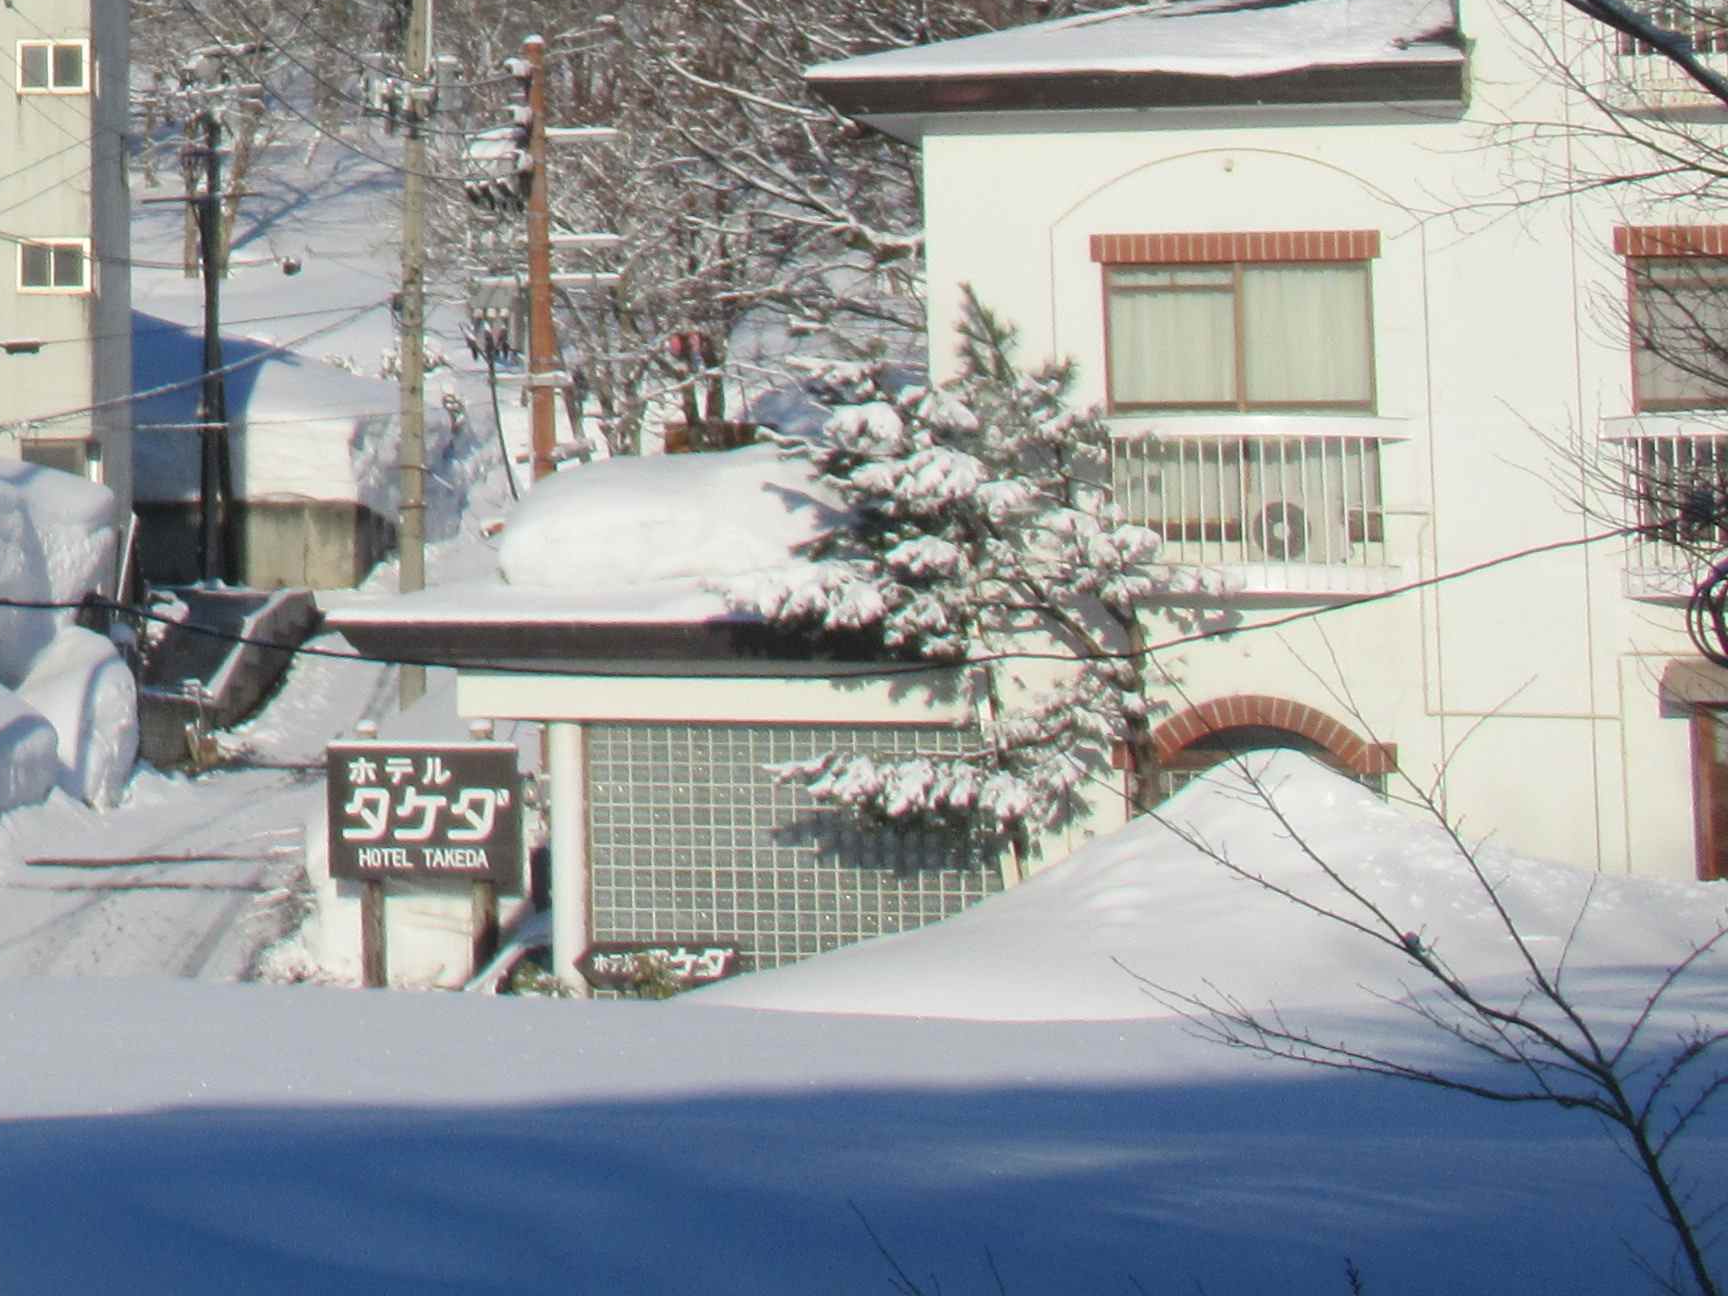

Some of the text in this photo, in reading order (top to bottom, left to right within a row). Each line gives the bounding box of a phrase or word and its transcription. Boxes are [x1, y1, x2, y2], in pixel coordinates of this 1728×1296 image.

[348, 757, 451, 784] ホテル
[343, 786, 510, 840] タケダ
[358, 848, 489, 869] HOTEL TAKEDA
